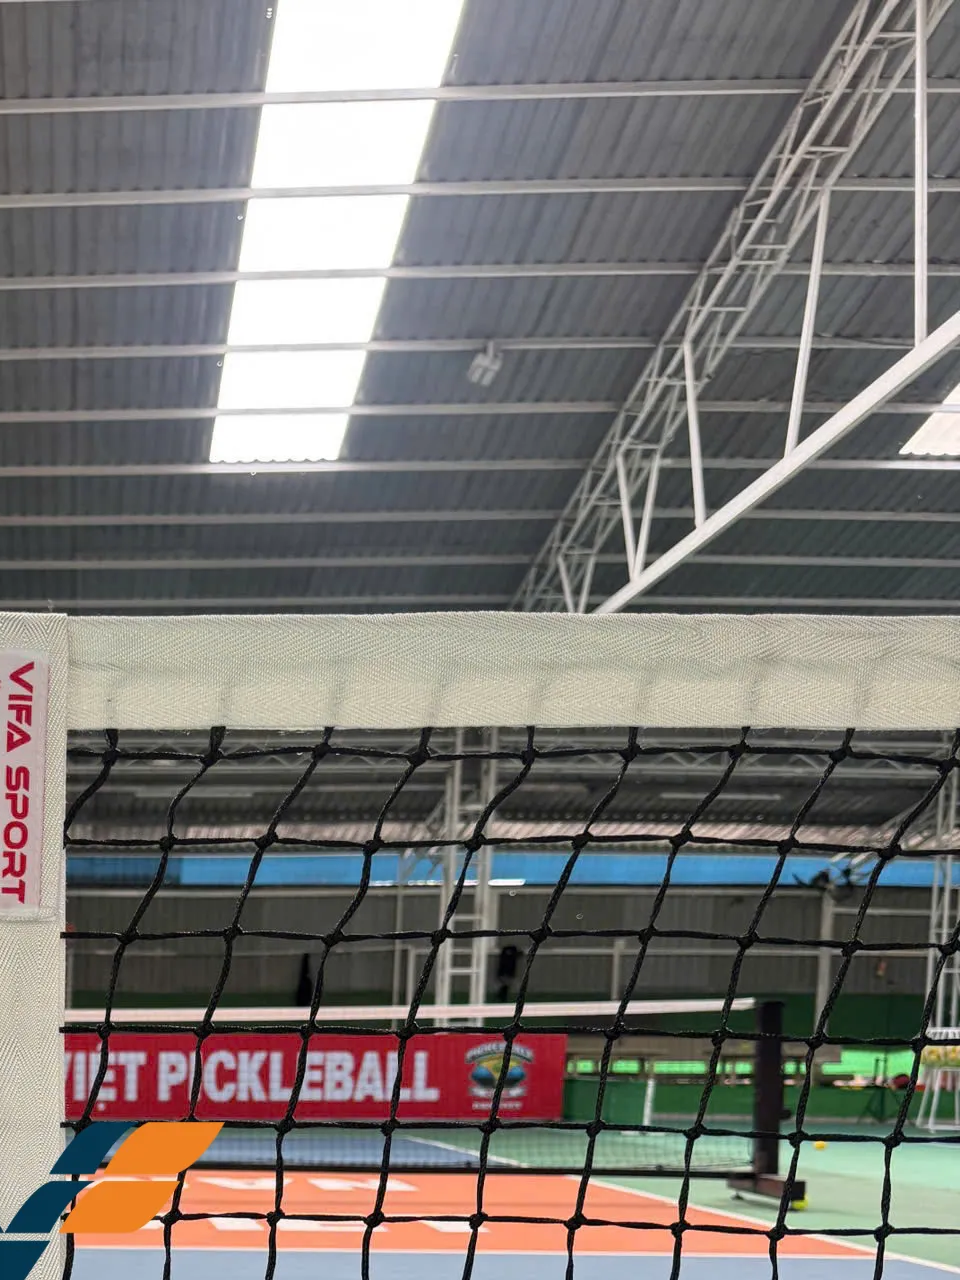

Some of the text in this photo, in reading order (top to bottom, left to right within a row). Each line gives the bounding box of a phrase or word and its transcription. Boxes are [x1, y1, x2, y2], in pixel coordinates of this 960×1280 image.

[1, 661, 35, 904] VIFA SPORT
[157, 1050, 439, 1102] PICKLEBALL
